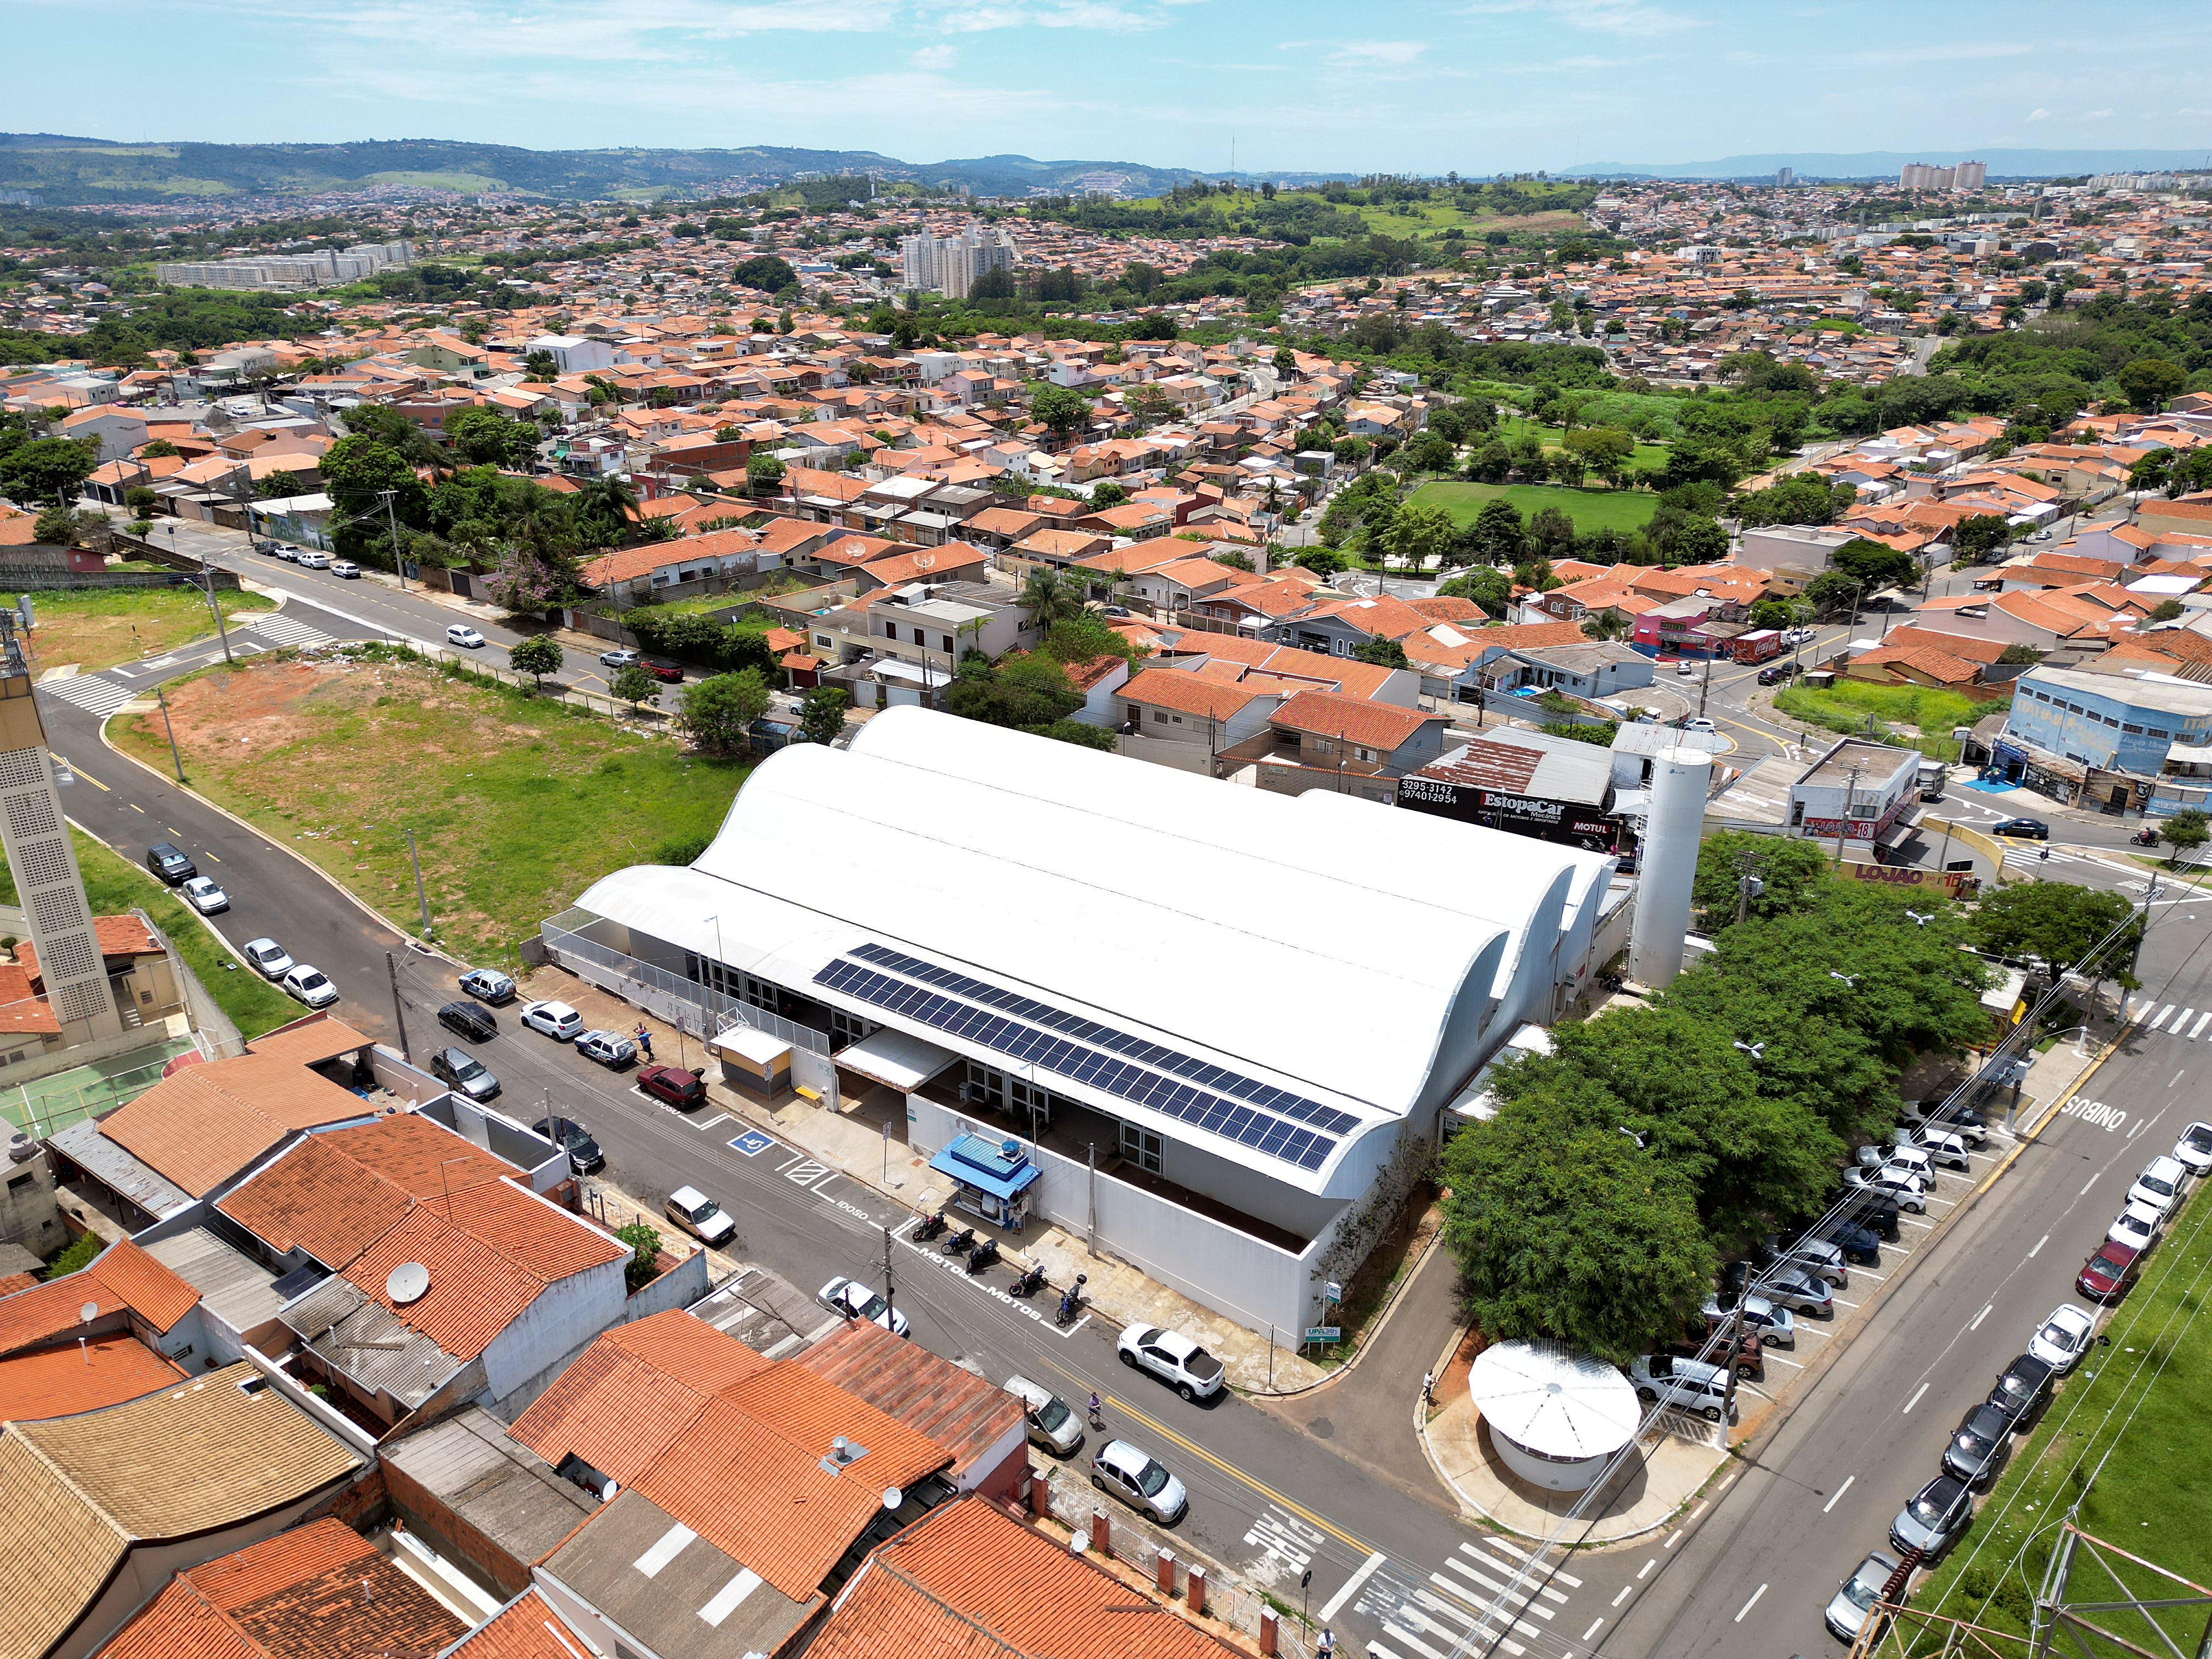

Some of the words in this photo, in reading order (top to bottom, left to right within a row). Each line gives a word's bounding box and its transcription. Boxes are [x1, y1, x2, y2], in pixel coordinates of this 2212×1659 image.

[1403, 780, 1452, 794] 3295-3142
[1404, 789, 1457, 804] 97401-2954
[1483, 793, 1565, 815] EstopaCar
[1574, 822, 1607, 833] MOTUL
[2061, 1096, 2126, 1132] ÔNIBUS
[836, 1200, 868, 1220] IDOSO
[919, 1247, 970, 1280] MOTOS
[986, 1286, 1042, 1321] MOTOS
[1243, 1504, 1325, 1575] PARE
